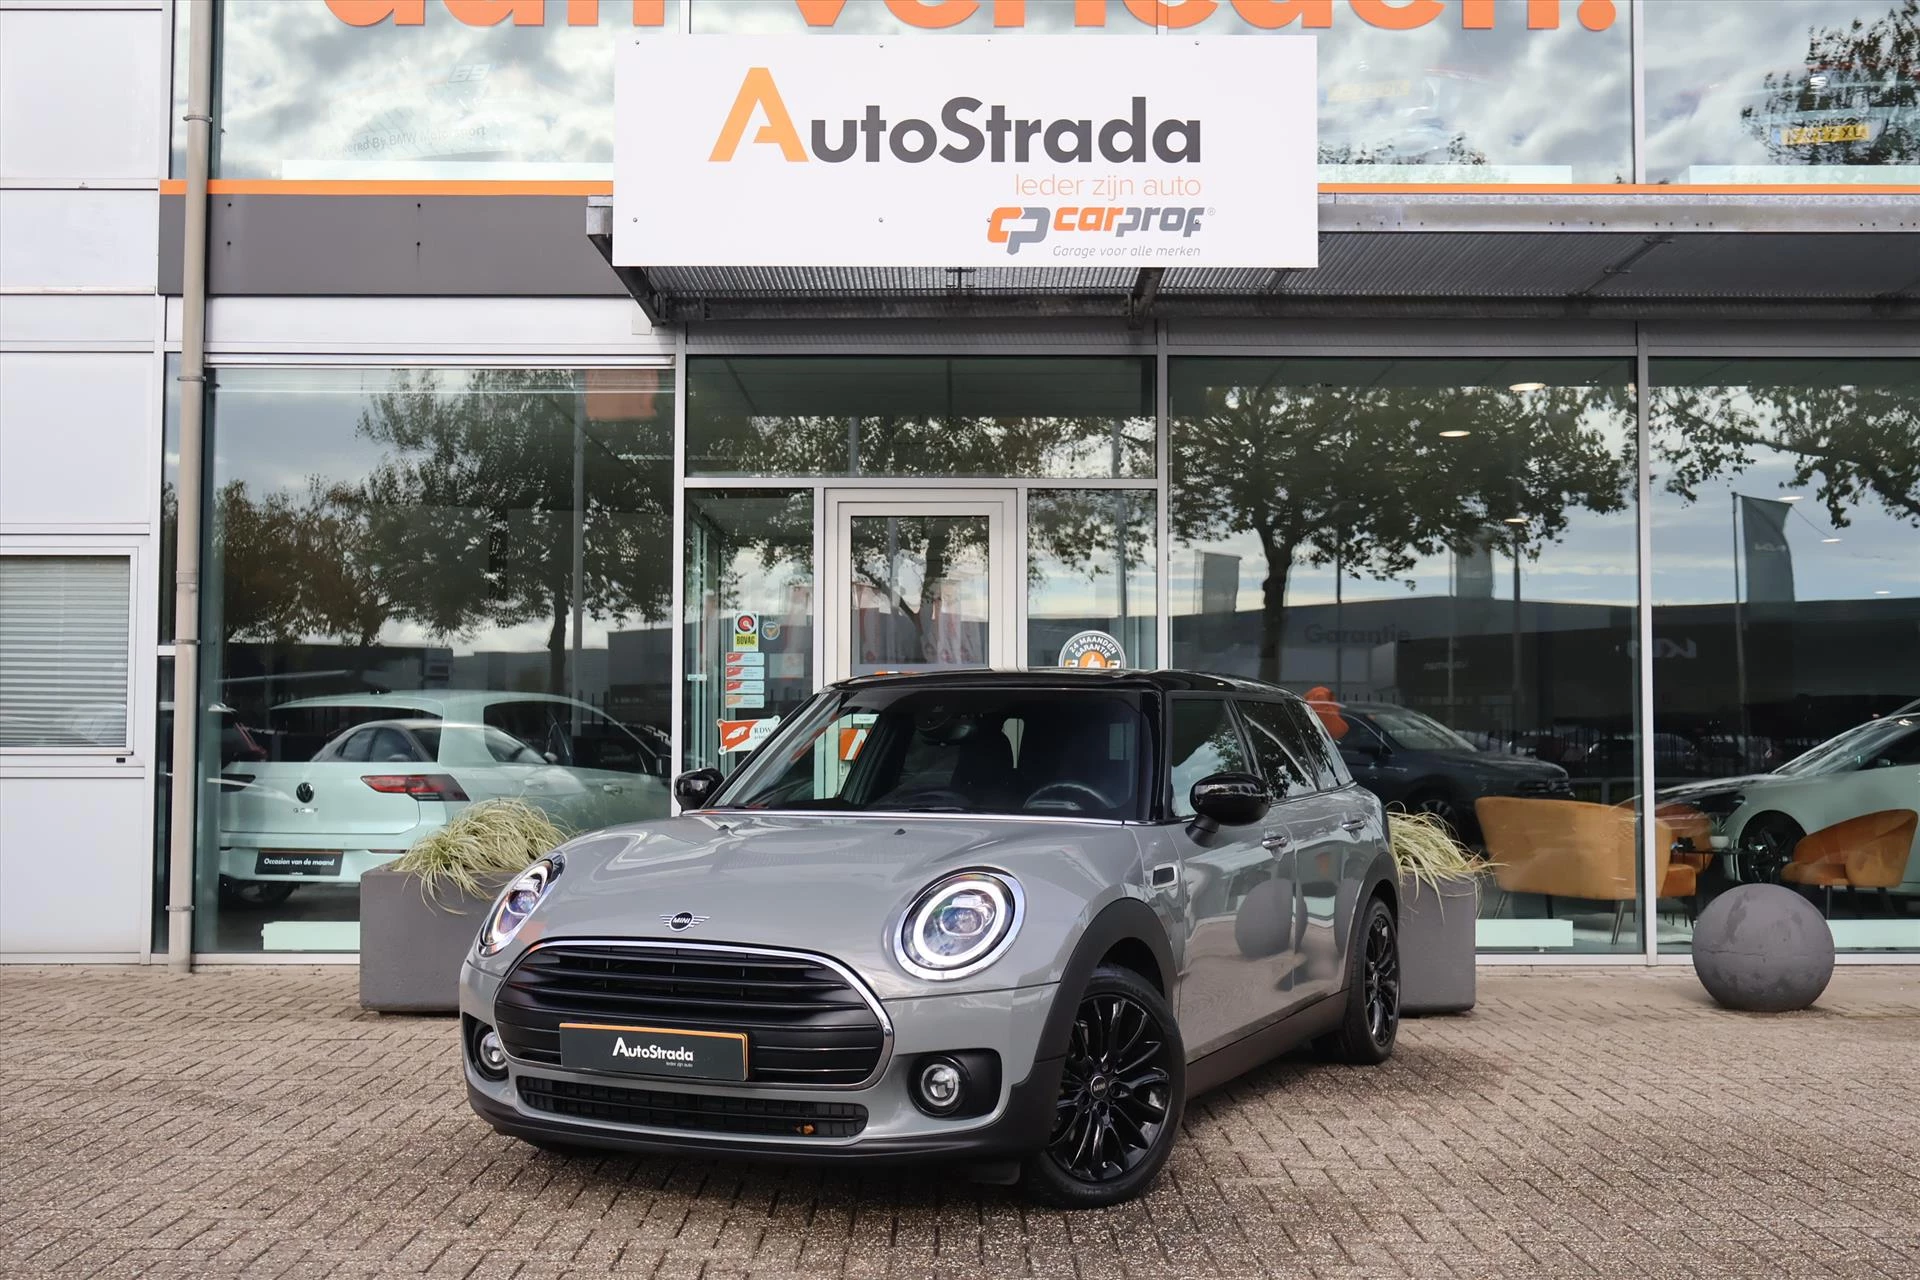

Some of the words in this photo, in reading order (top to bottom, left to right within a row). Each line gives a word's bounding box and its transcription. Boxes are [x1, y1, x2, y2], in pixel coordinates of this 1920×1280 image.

[707, 67, 1201, 164] AutoStrada
[1015, 174, 1085, 196] Ieder
[1092, 175, 1134, 201] zijn
[1143, 176, 1201, 196] auto
[1052, 245, 1096, 259] Garage
[1100, 246, 1127, 257] voor
[1130, 244, 1153, 257] alle
[1156, 244, 1201, 257] merken
[736, 635, 756, 645] BOVAG
[1069, 642, 1079, 654] 24
[1079, 636, 1117, 655] MAANDEN
[1074, 643, 1112, 659] GARANTIE
[264, 857, 290, 865] Occasion
[303, 858, 312, 866] de
[312, 858, 335, 867] maand
[612, 1037, 694, 1061] AutoStrada
